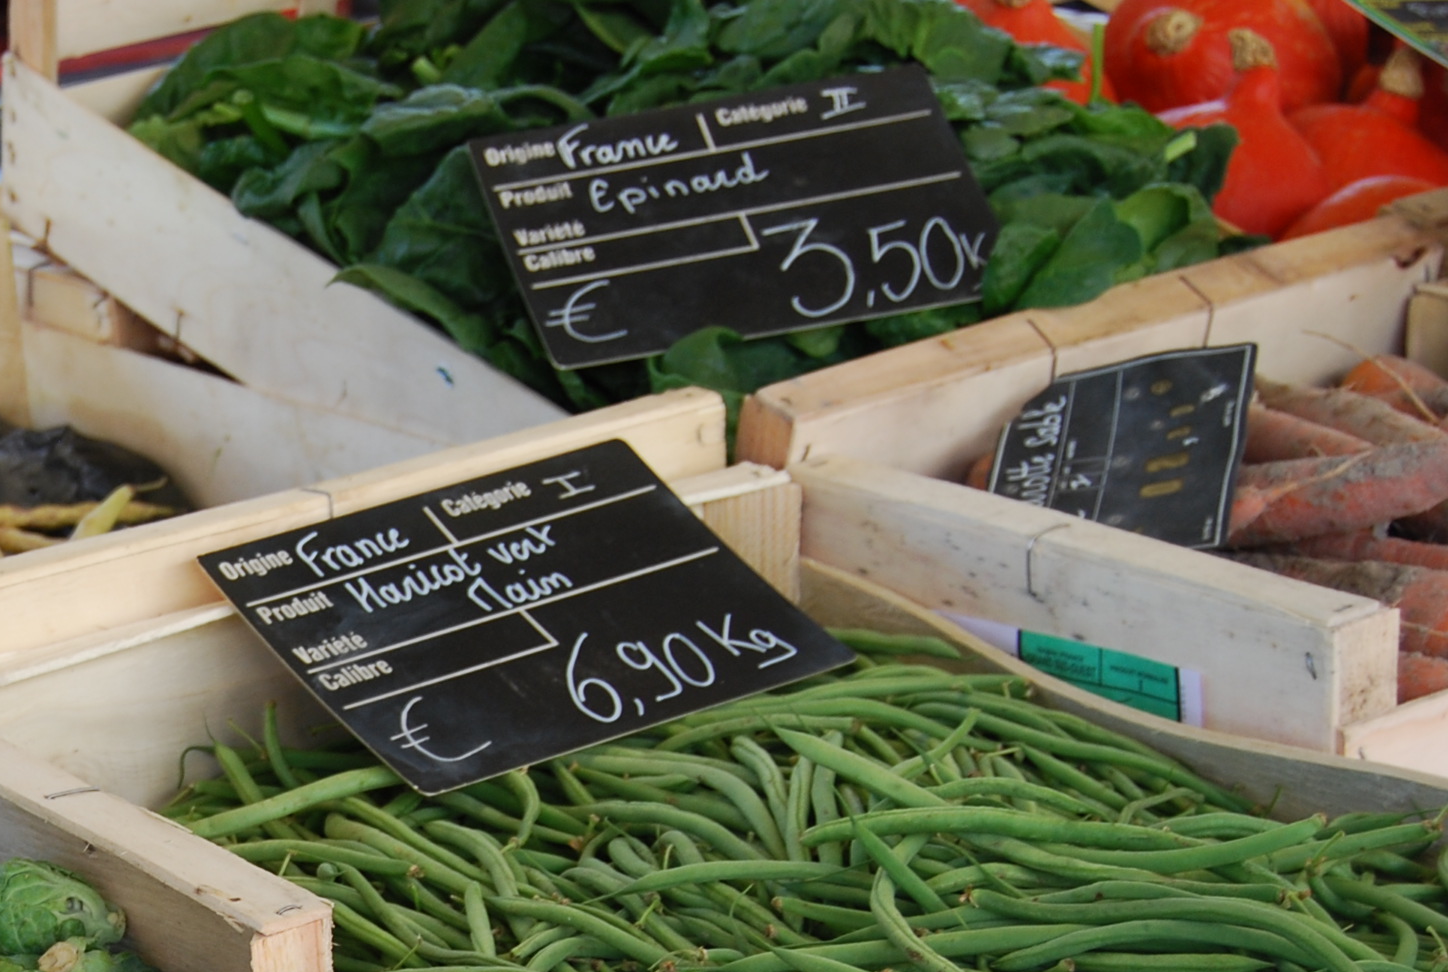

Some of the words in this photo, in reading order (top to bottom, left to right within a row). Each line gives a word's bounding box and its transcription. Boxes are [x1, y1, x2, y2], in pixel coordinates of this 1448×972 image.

[485, 141, 555, 167] Origine
[557, 124, 679, 170] France
[715, 95, 807, 127] Catégorie
[498, 183, 572, 209] Produit
[588, 152, 769, 213] Epinard
[514, 220, 585, 247] Variété
[523, 245, 596, 273] Calibre
[218, 546, 293, 584] Origine
[296, 525, 411, 579] France
[440, 479, 533, 519] Catégorie
[256, 594, 335, 627] Produit
[344, 546, 482, 613] Haricot
[486, 524, 557, 565] vert
[292, 630, 369, 668] Variété
[318, 656, 394, 695] Calibre
